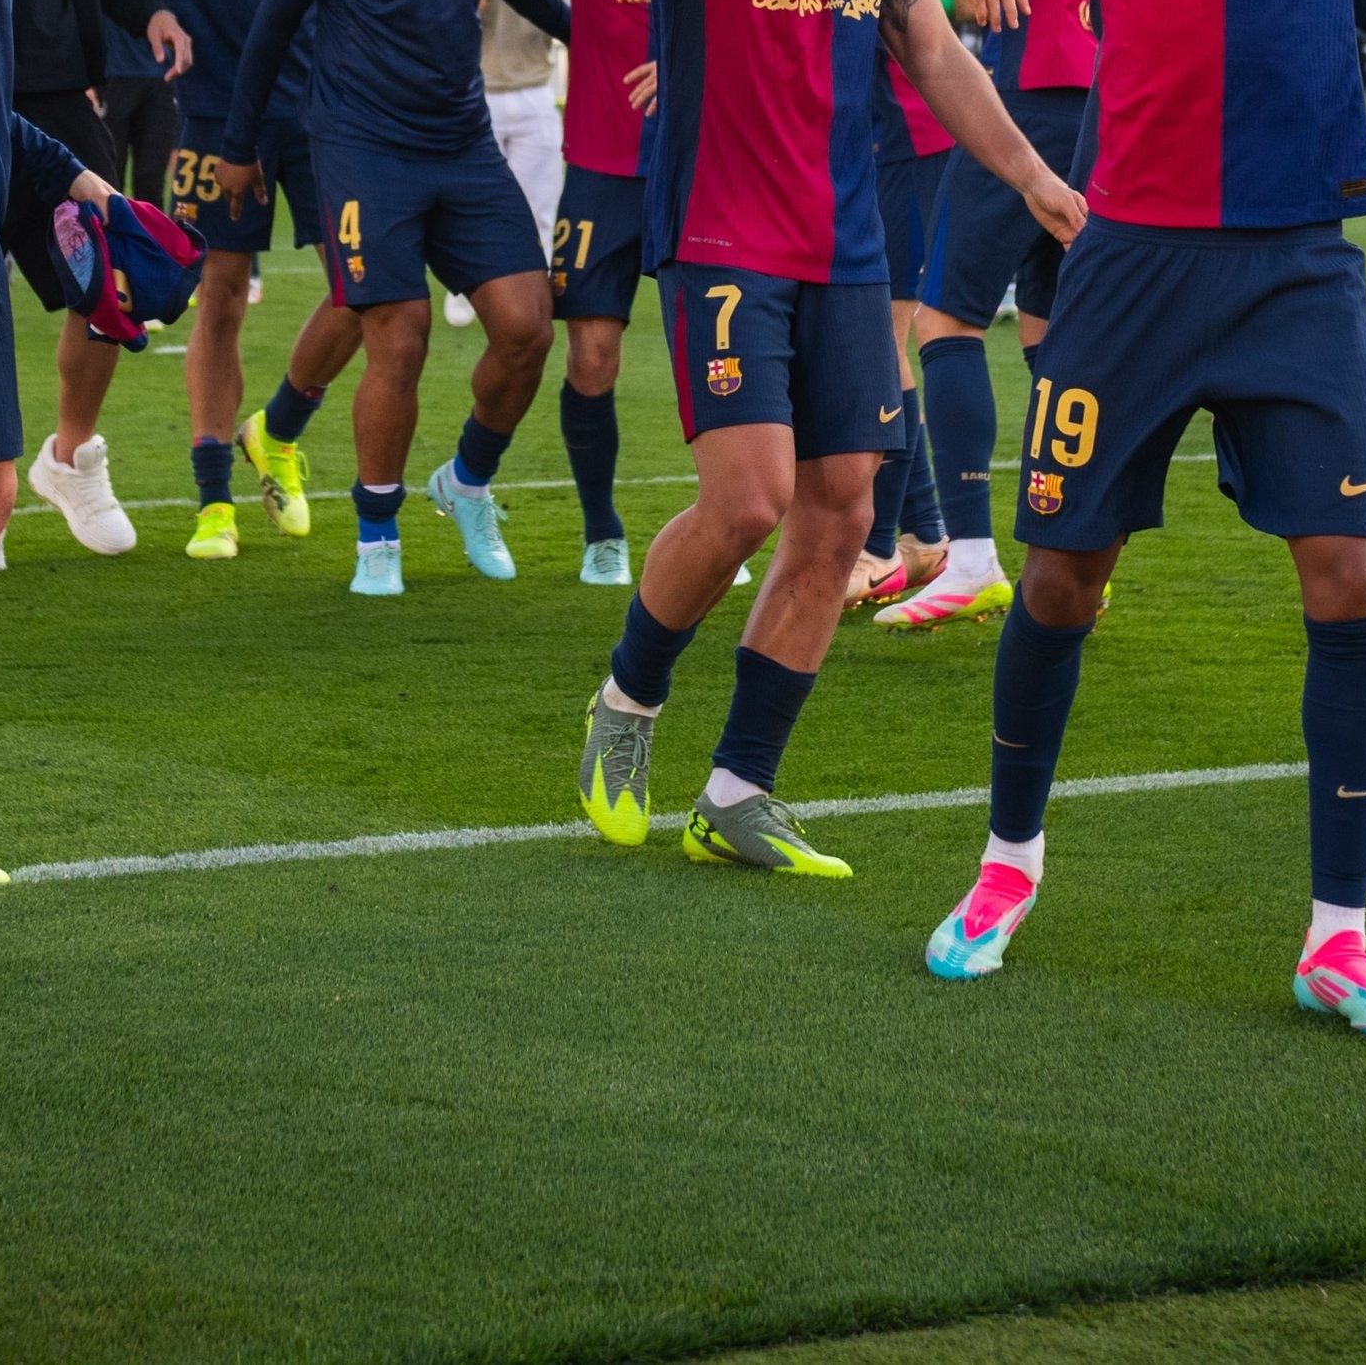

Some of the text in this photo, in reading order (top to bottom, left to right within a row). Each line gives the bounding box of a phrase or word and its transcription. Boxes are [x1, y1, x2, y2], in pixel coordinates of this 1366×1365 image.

[172, 149, 222, 202] 35
[338, 200, 362, 250] 4
[552, 218, 595, 269] 21
[704, 284, 743, 350] 7
[1030, 377, 1099, 468] 19
